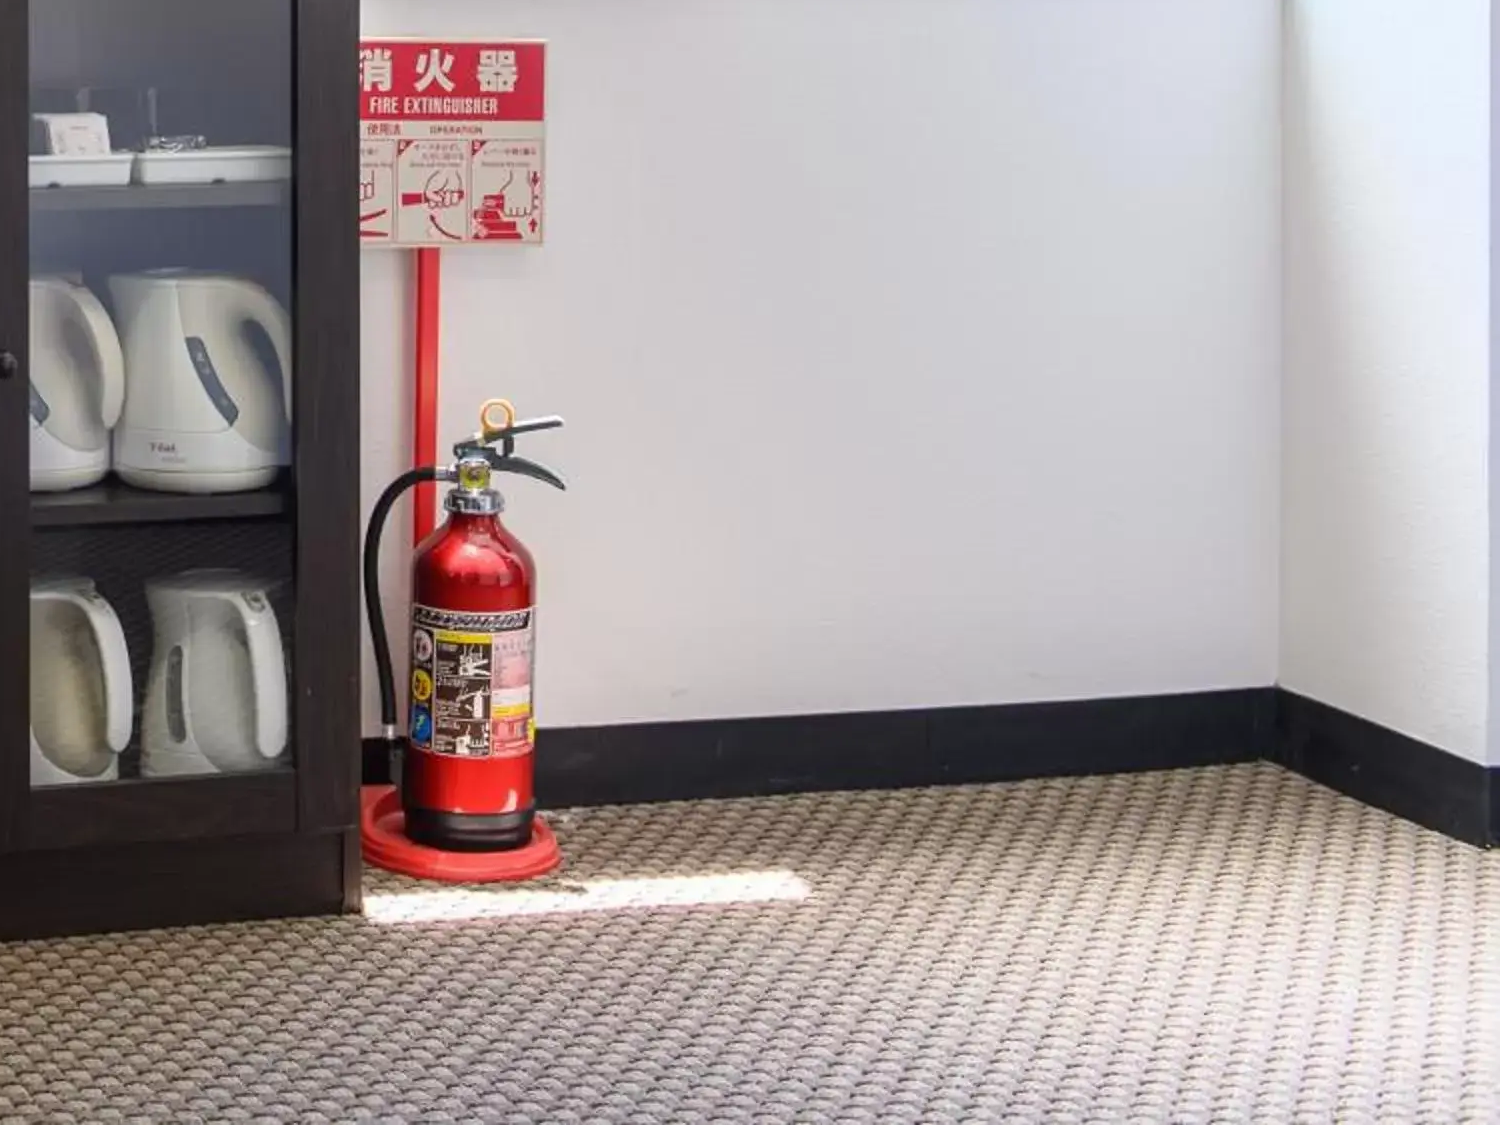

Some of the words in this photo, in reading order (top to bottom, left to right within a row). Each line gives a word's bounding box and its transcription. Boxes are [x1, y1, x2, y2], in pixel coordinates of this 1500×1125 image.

[369, 96, 399, 114] FIRE
[403, 97, 498, 115] EXTINGUISHER
[429, 125, 483, 136] OPERATION
